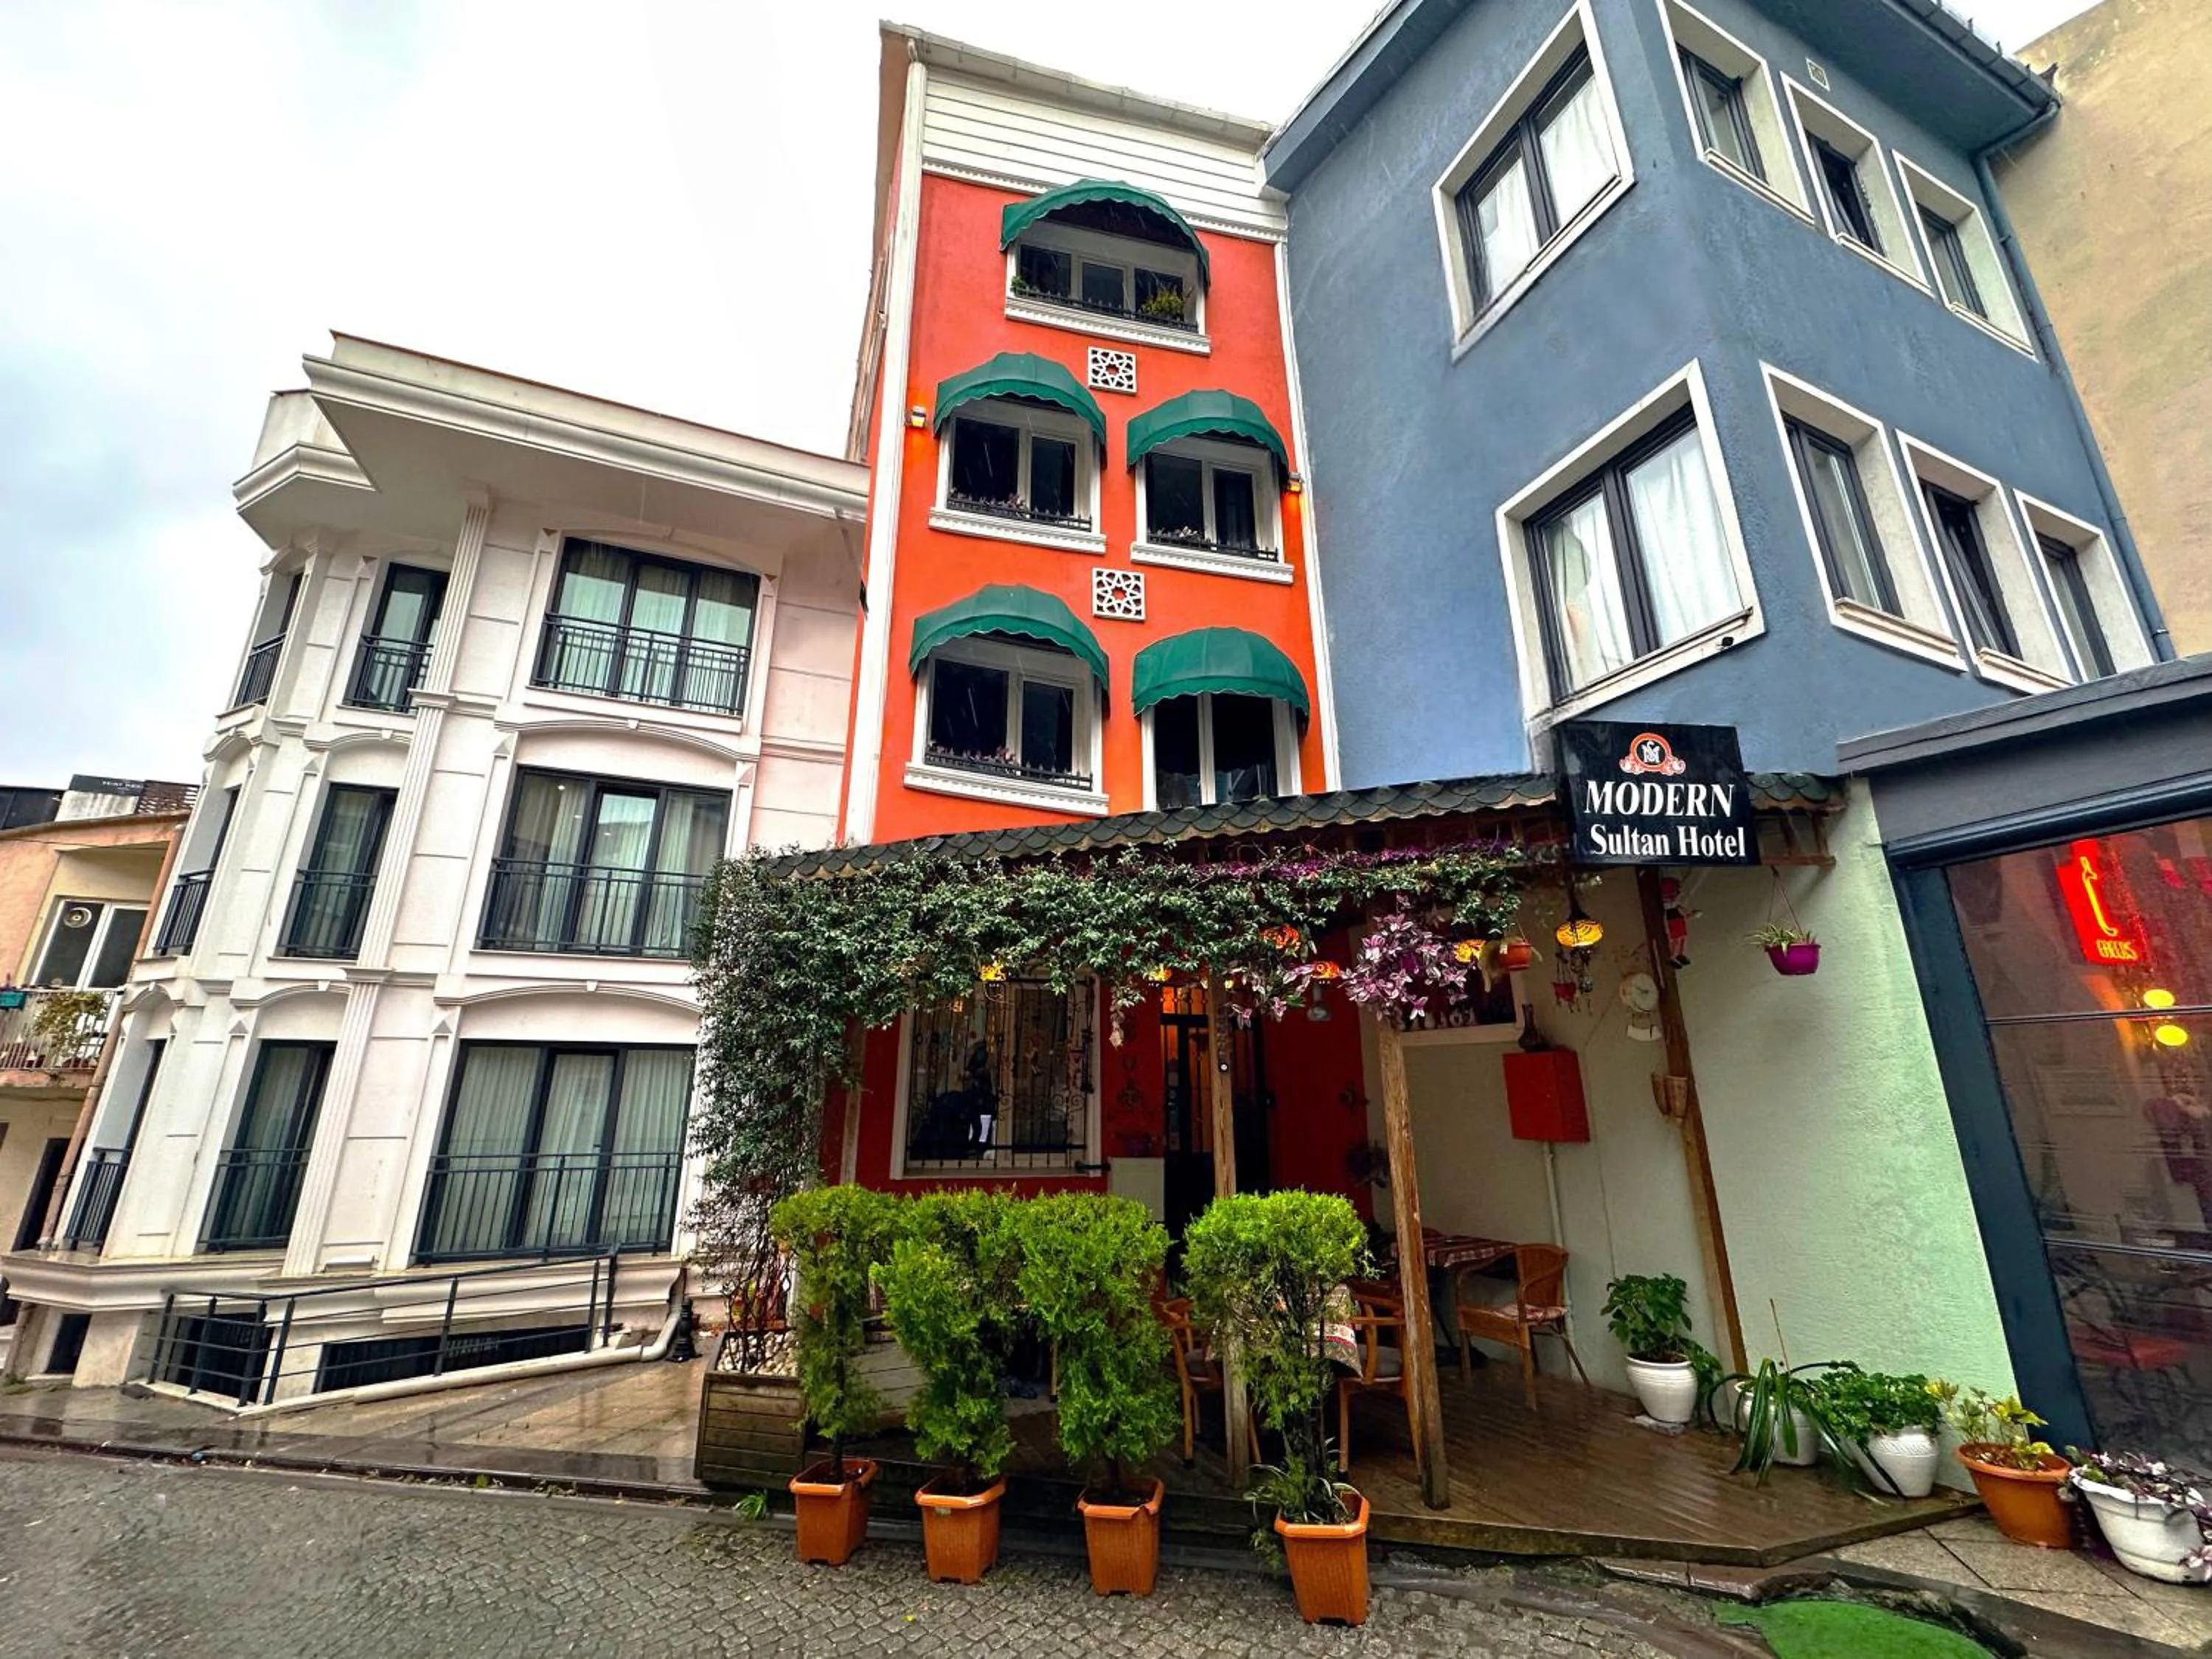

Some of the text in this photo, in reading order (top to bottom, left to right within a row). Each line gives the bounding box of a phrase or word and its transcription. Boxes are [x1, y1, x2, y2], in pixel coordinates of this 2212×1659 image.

[1584, 779, 1734, 818] MODERN
[1590, 824, 1746, 857] Sultan Hotel
